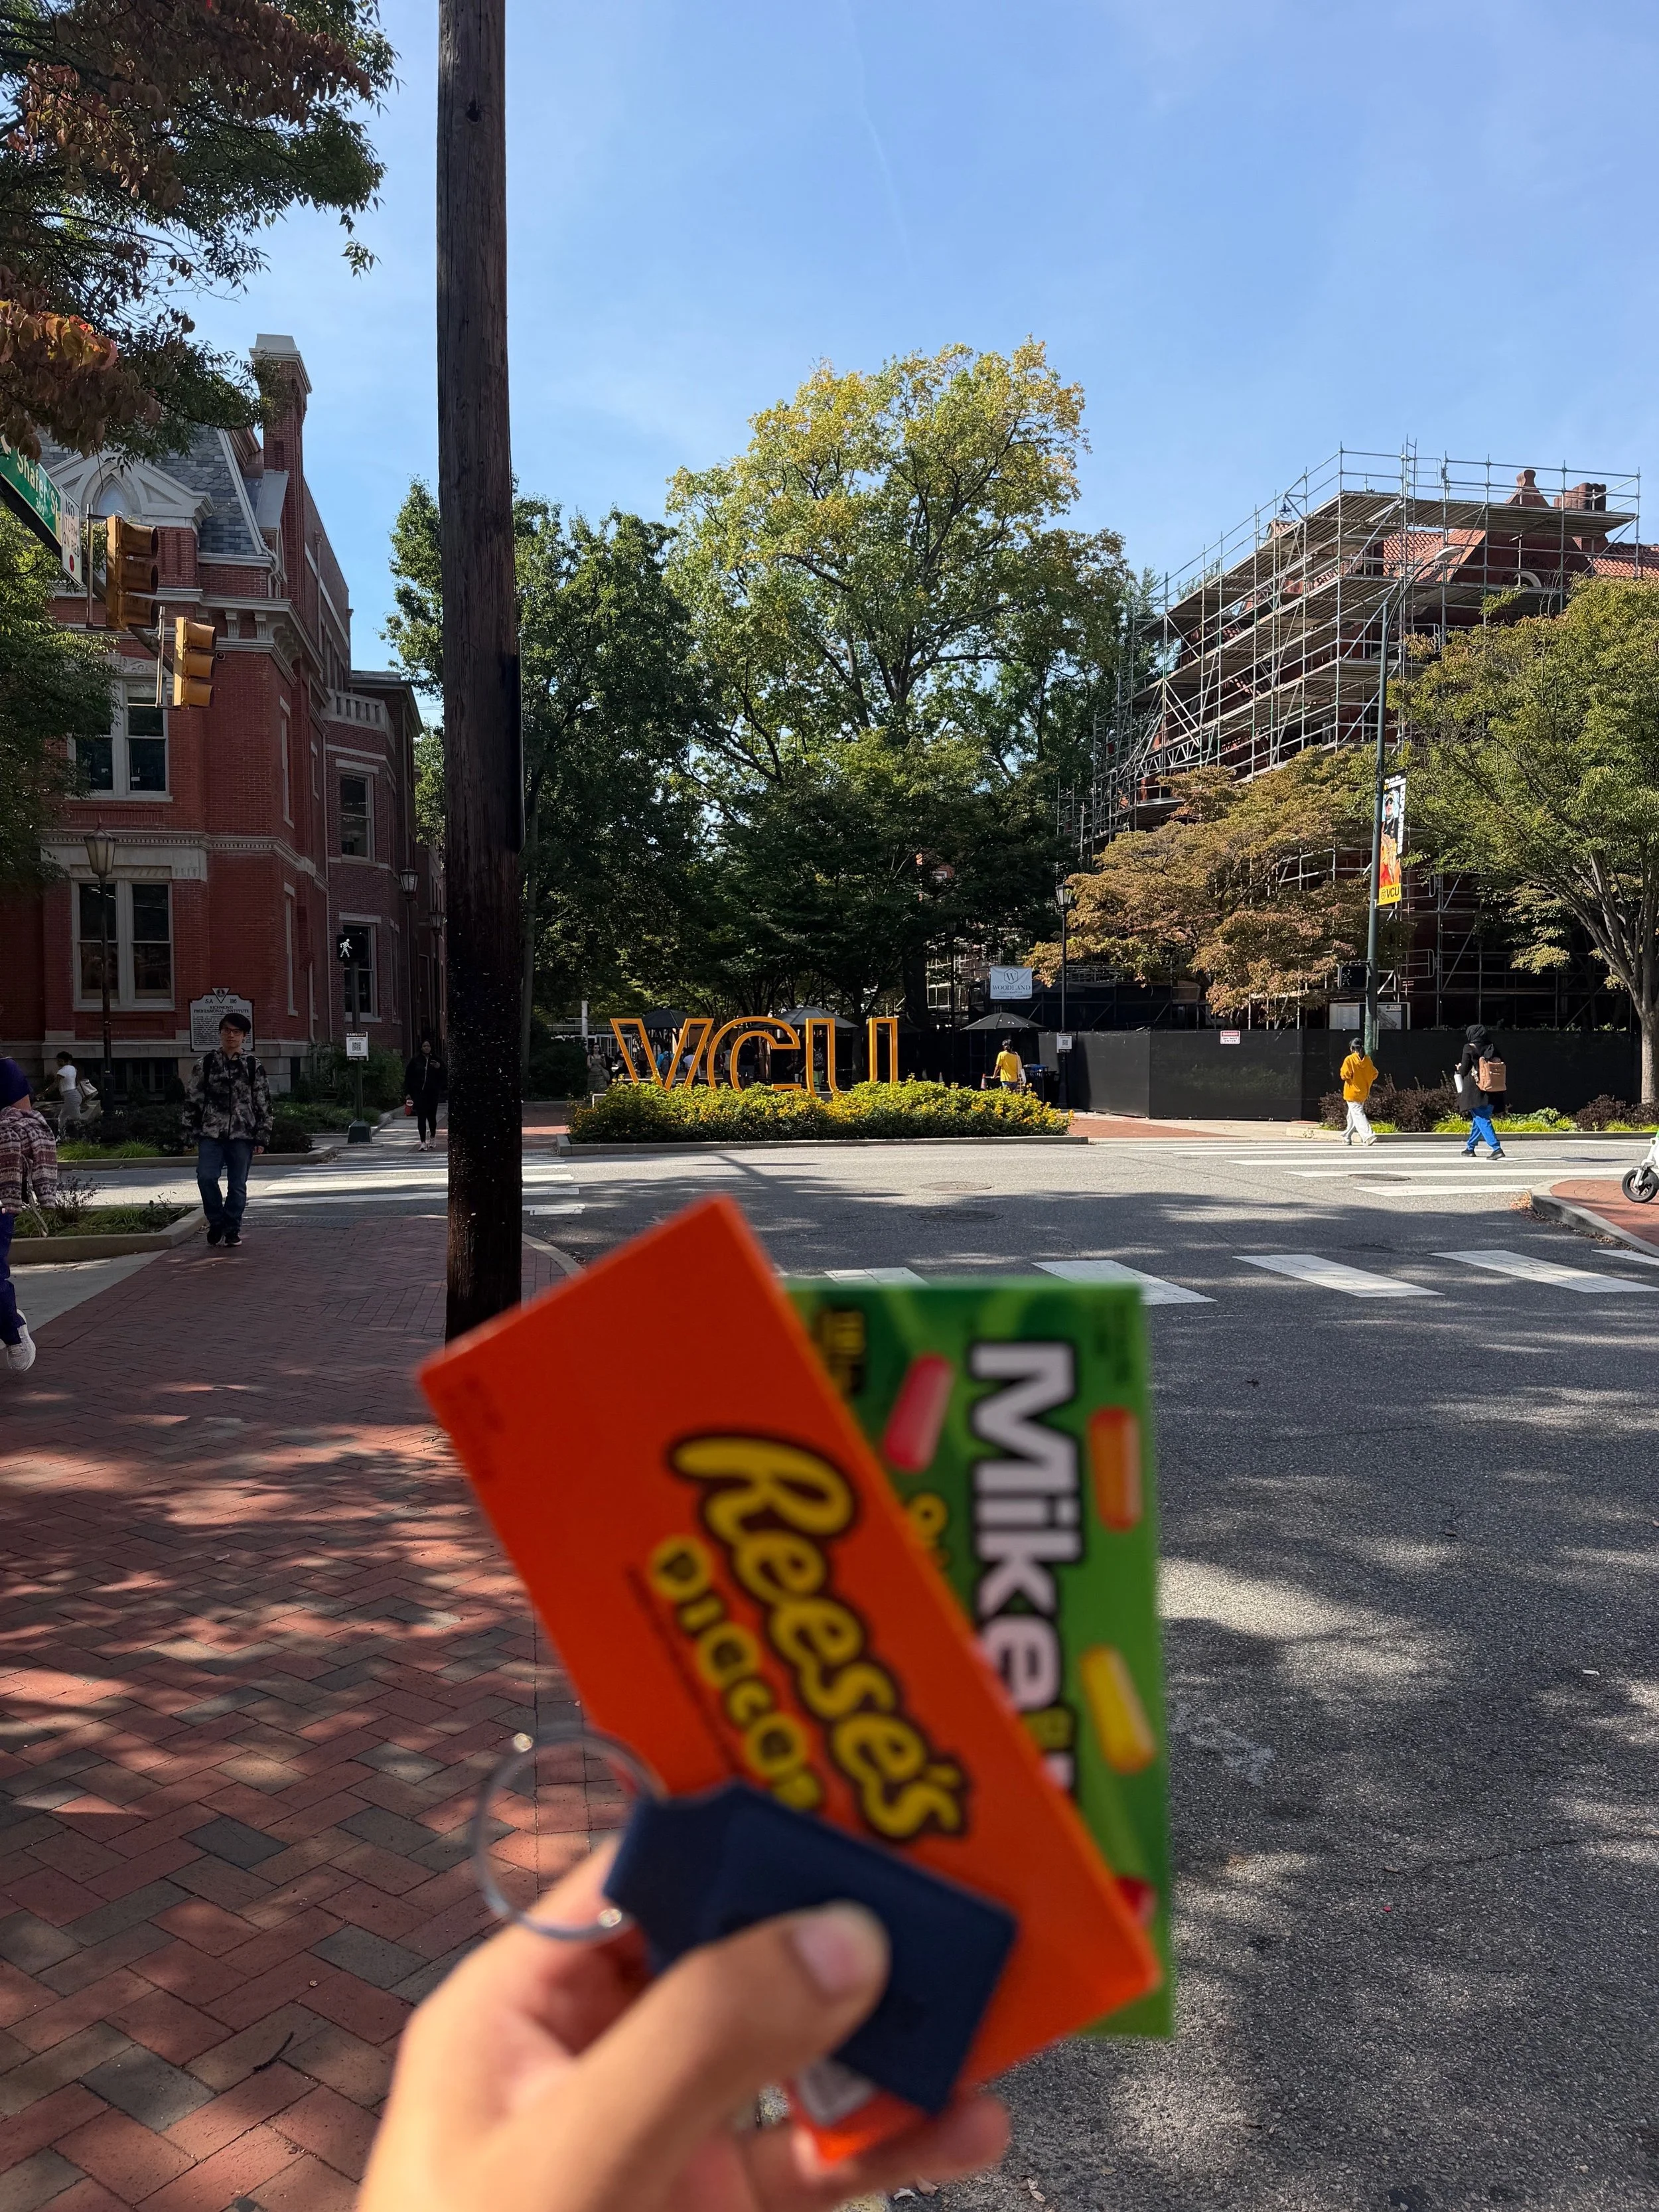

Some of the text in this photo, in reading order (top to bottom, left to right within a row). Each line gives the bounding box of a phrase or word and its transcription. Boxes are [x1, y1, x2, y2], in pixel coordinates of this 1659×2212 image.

[17, 446, 58, 514] Shafer St
[65, 498, 75, 520] NO
[64, 516, 78, 539] TURN
[63, 532, 80, 558] ON RED
[1386, 886, 1400, 898] VCU
[1005, 972, 1017, 981] W
[610, 1015, 899, 1098] VCU
[968, 1341, 1083, 1714] Mike
[666, 1434, 970, 1840] Reese's
